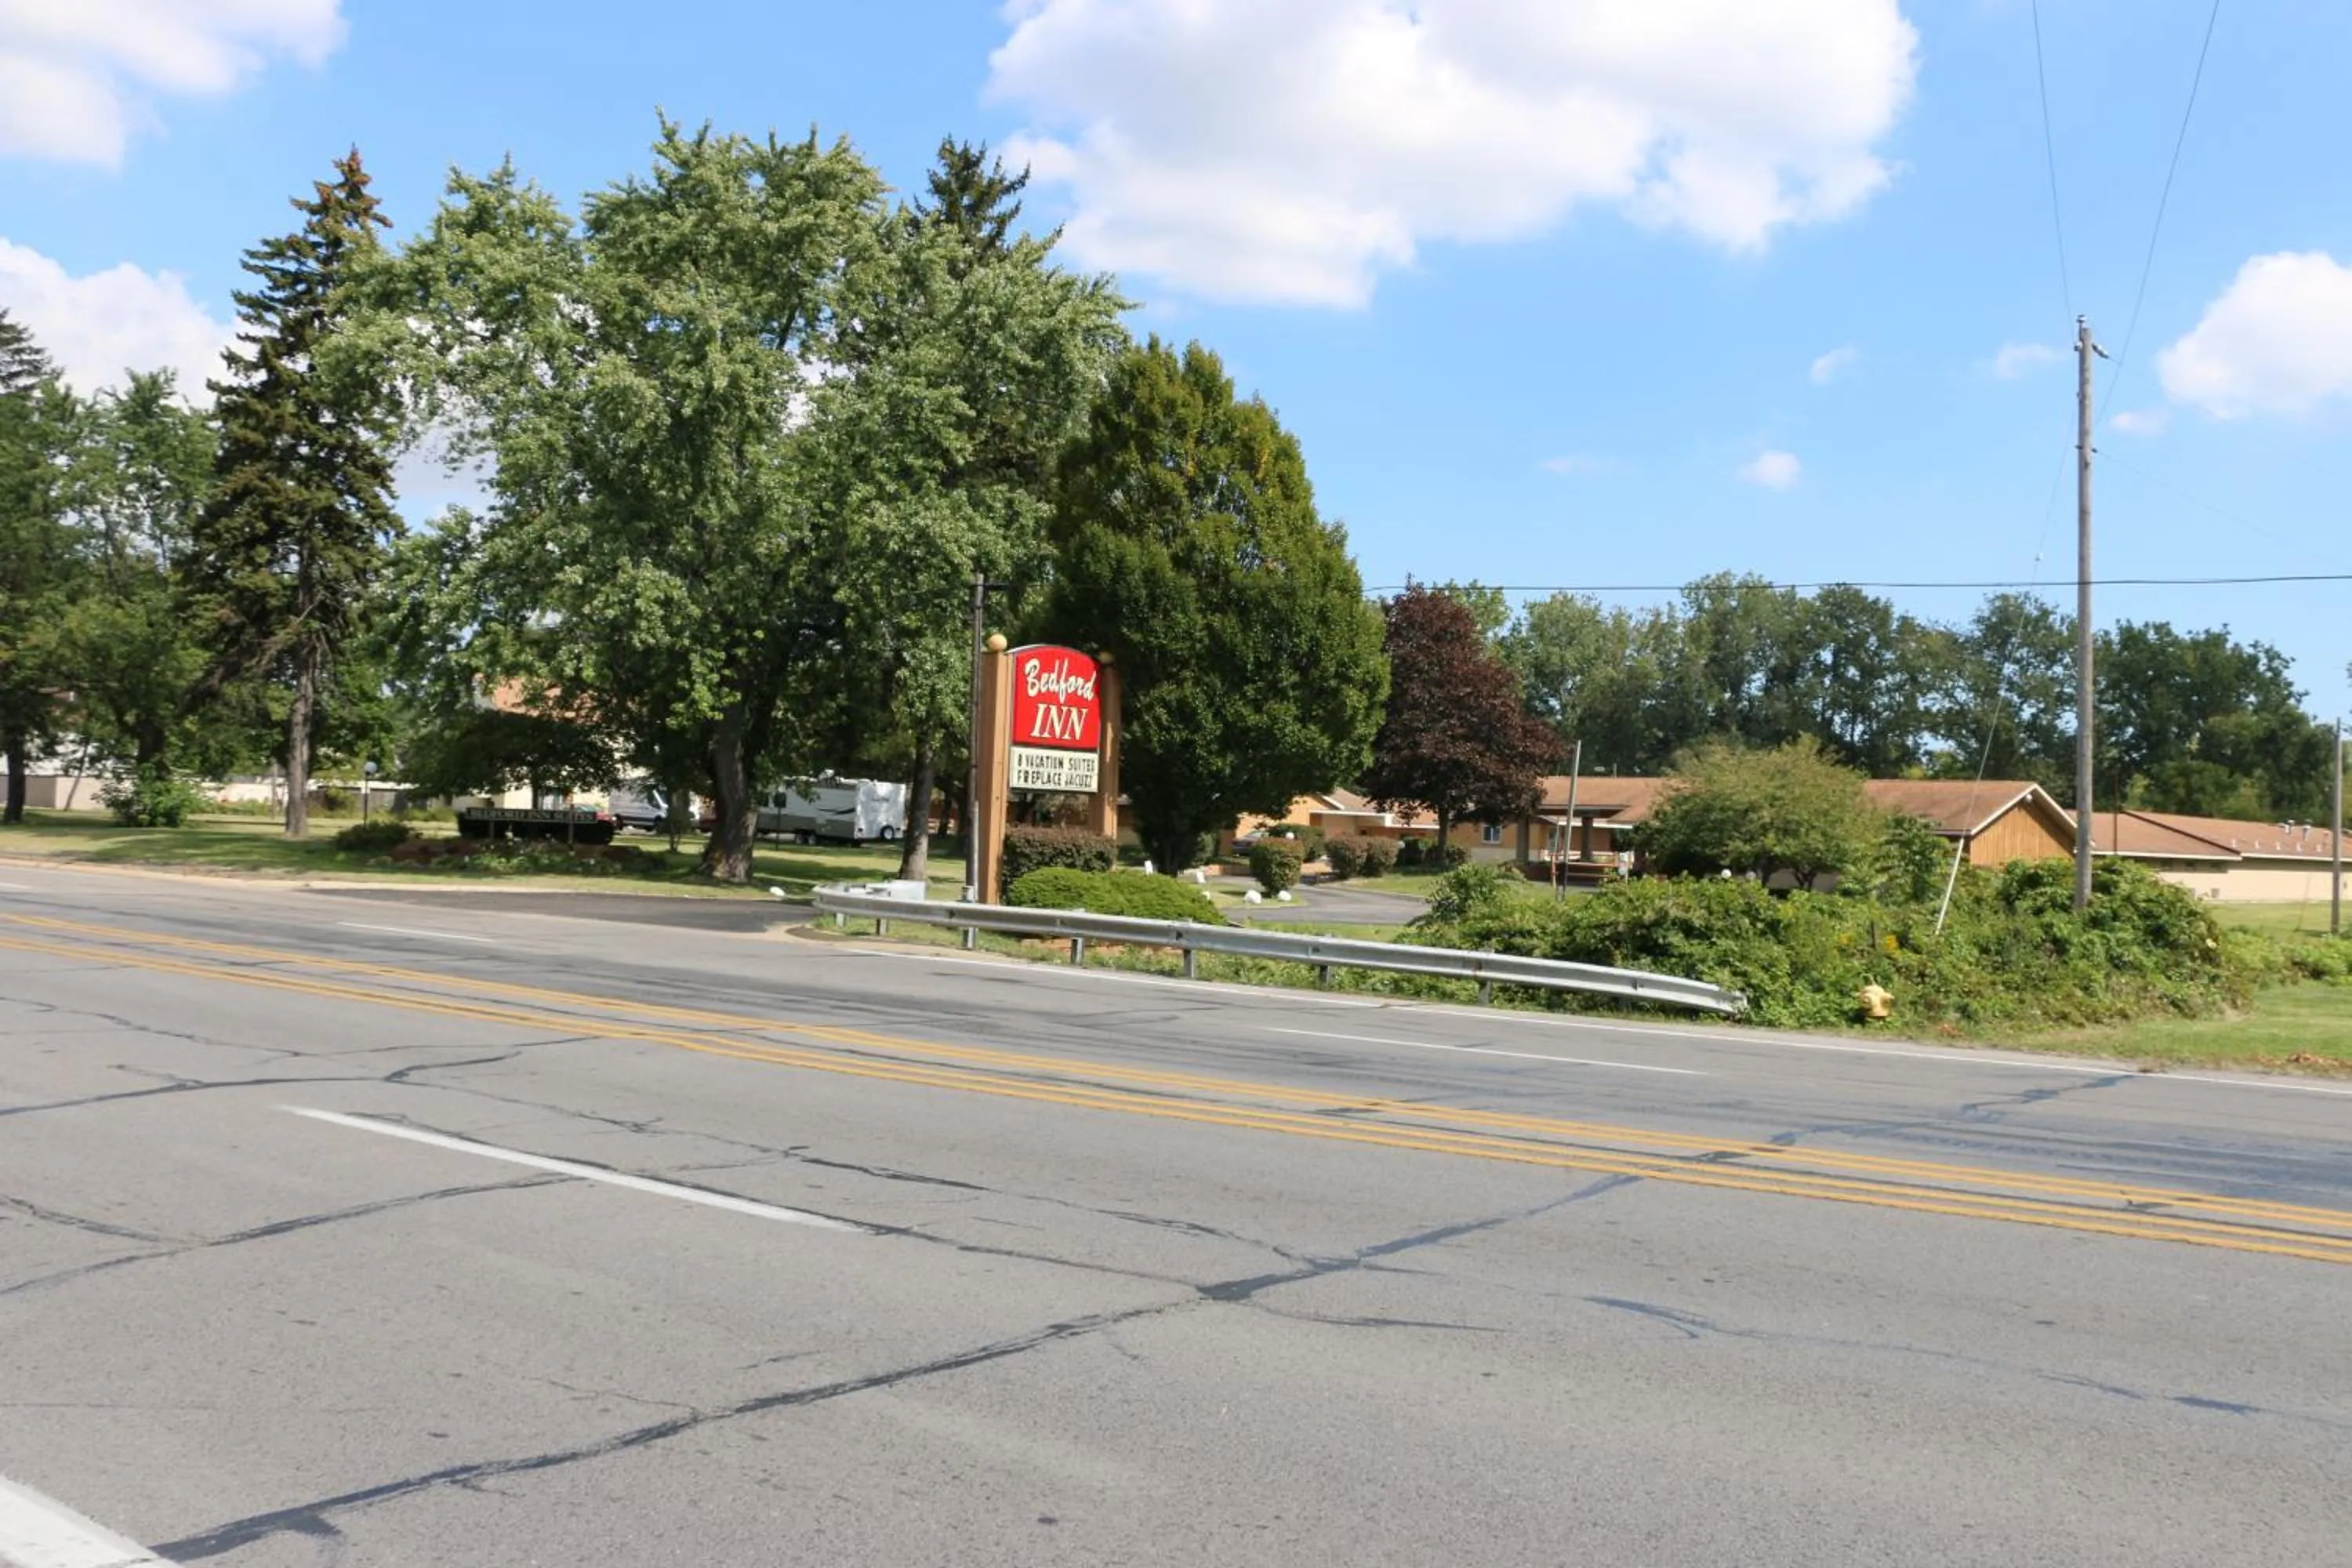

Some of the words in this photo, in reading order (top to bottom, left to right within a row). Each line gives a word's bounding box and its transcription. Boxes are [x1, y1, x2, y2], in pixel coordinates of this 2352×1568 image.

[1025, 658, 1096, 703] Bedford
[1030, 703, 1088, 741] INN
[1025, 754, 1064, 769] VACATION
[1069, 757, 1095, 772] SUITES
